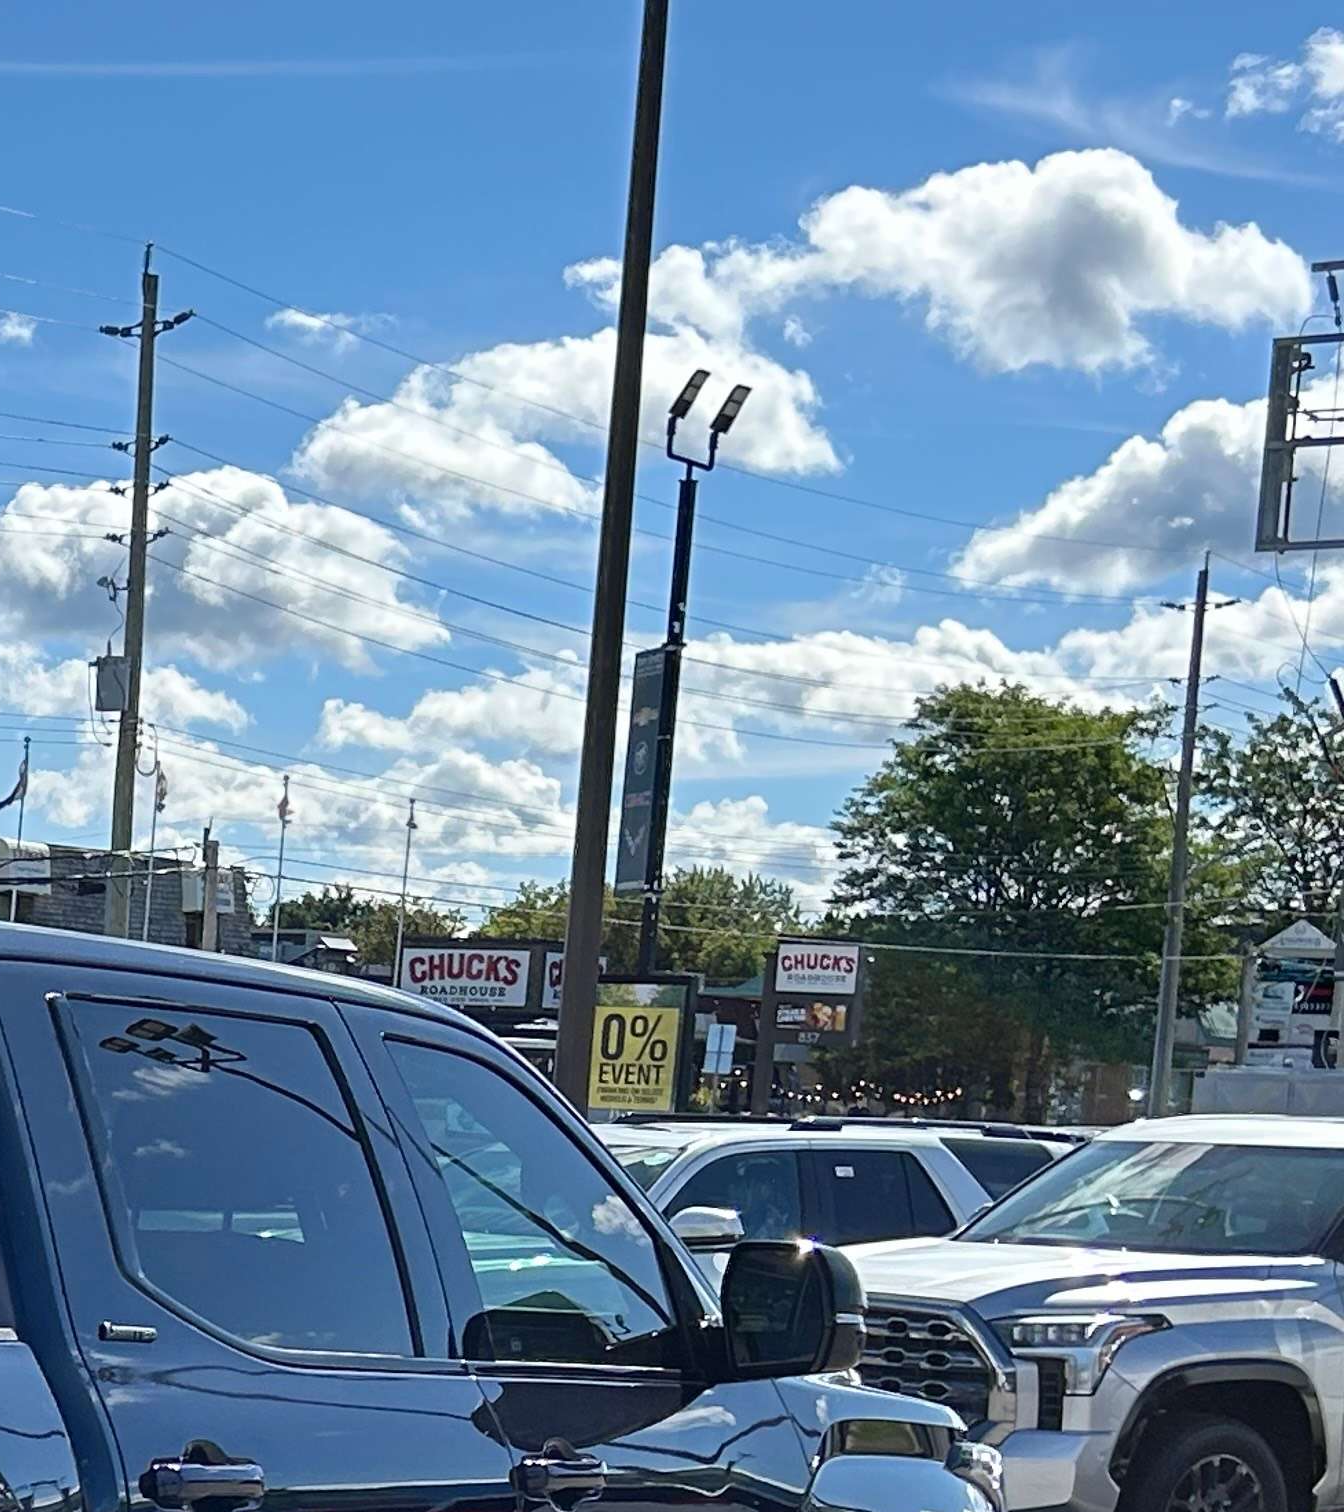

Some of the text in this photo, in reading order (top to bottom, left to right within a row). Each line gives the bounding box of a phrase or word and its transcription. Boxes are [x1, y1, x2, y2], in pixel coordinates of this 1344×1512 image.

[419, 985, 507, 998] ROADHOUSE
[600, 1013, 668, 1062] 0%
[598, 1063, 665, 1086] EVENT
